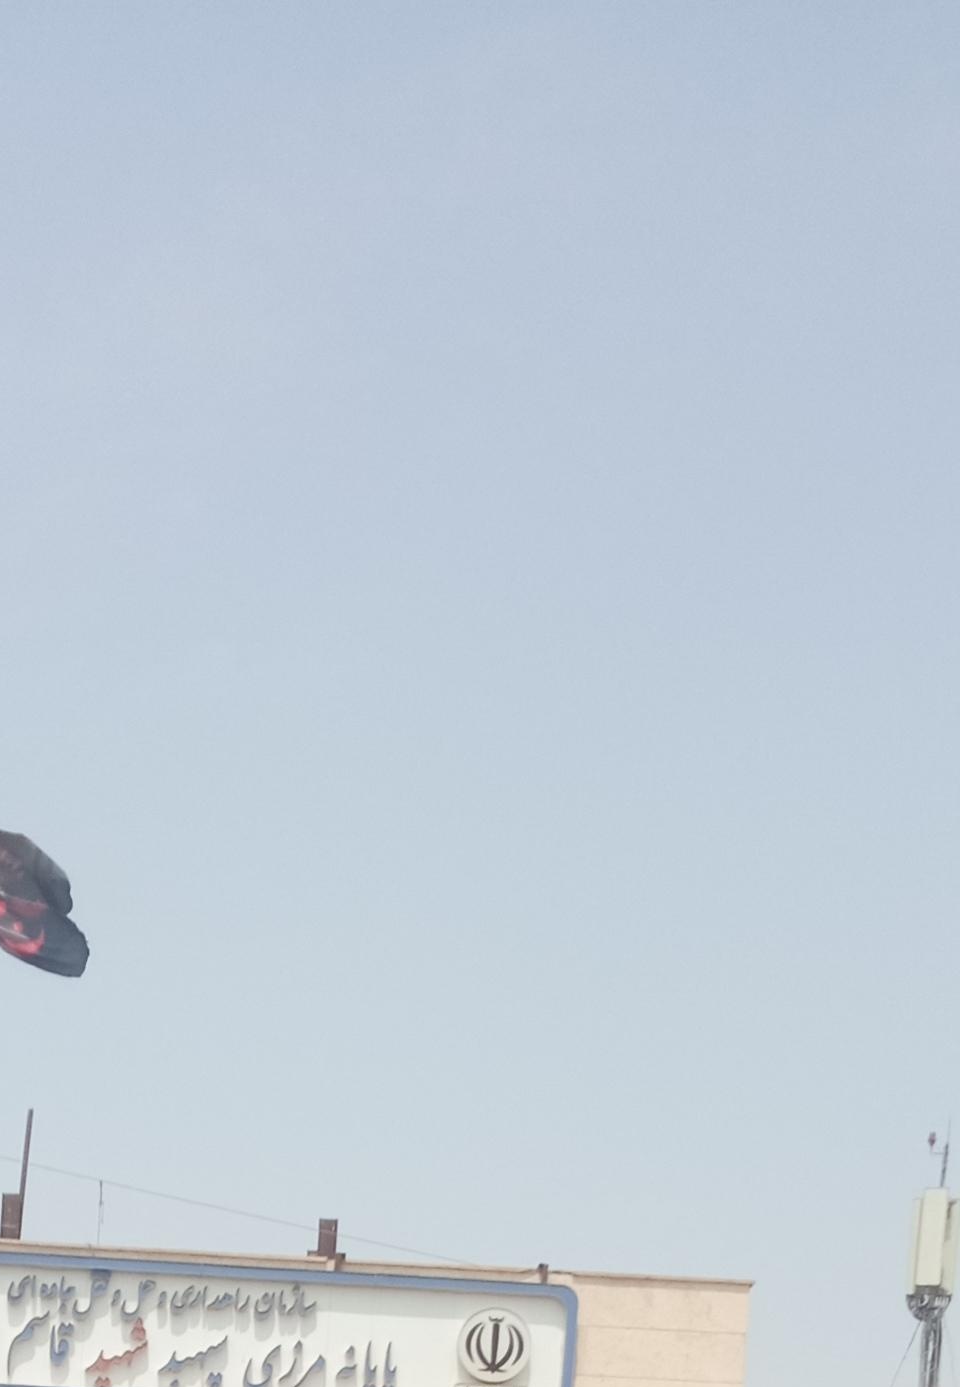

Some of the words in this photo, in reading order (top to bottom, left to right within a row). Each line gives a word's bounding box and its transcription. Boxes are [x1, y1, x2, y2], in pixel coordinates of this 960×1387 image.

[7, 1274, 37, 1303] ای
[40, 1275, 76, 1314] جاده
[111, 1288, 121, 1306] و
[158, 1290, 167, 1308] و
[171, 1285, 251, 1312] راهداری
[254, 1282, 316, 1314] سازمان
[7, 1310, 74, 1377] قاسم
[85, 1317, 148, 1387] شهید
